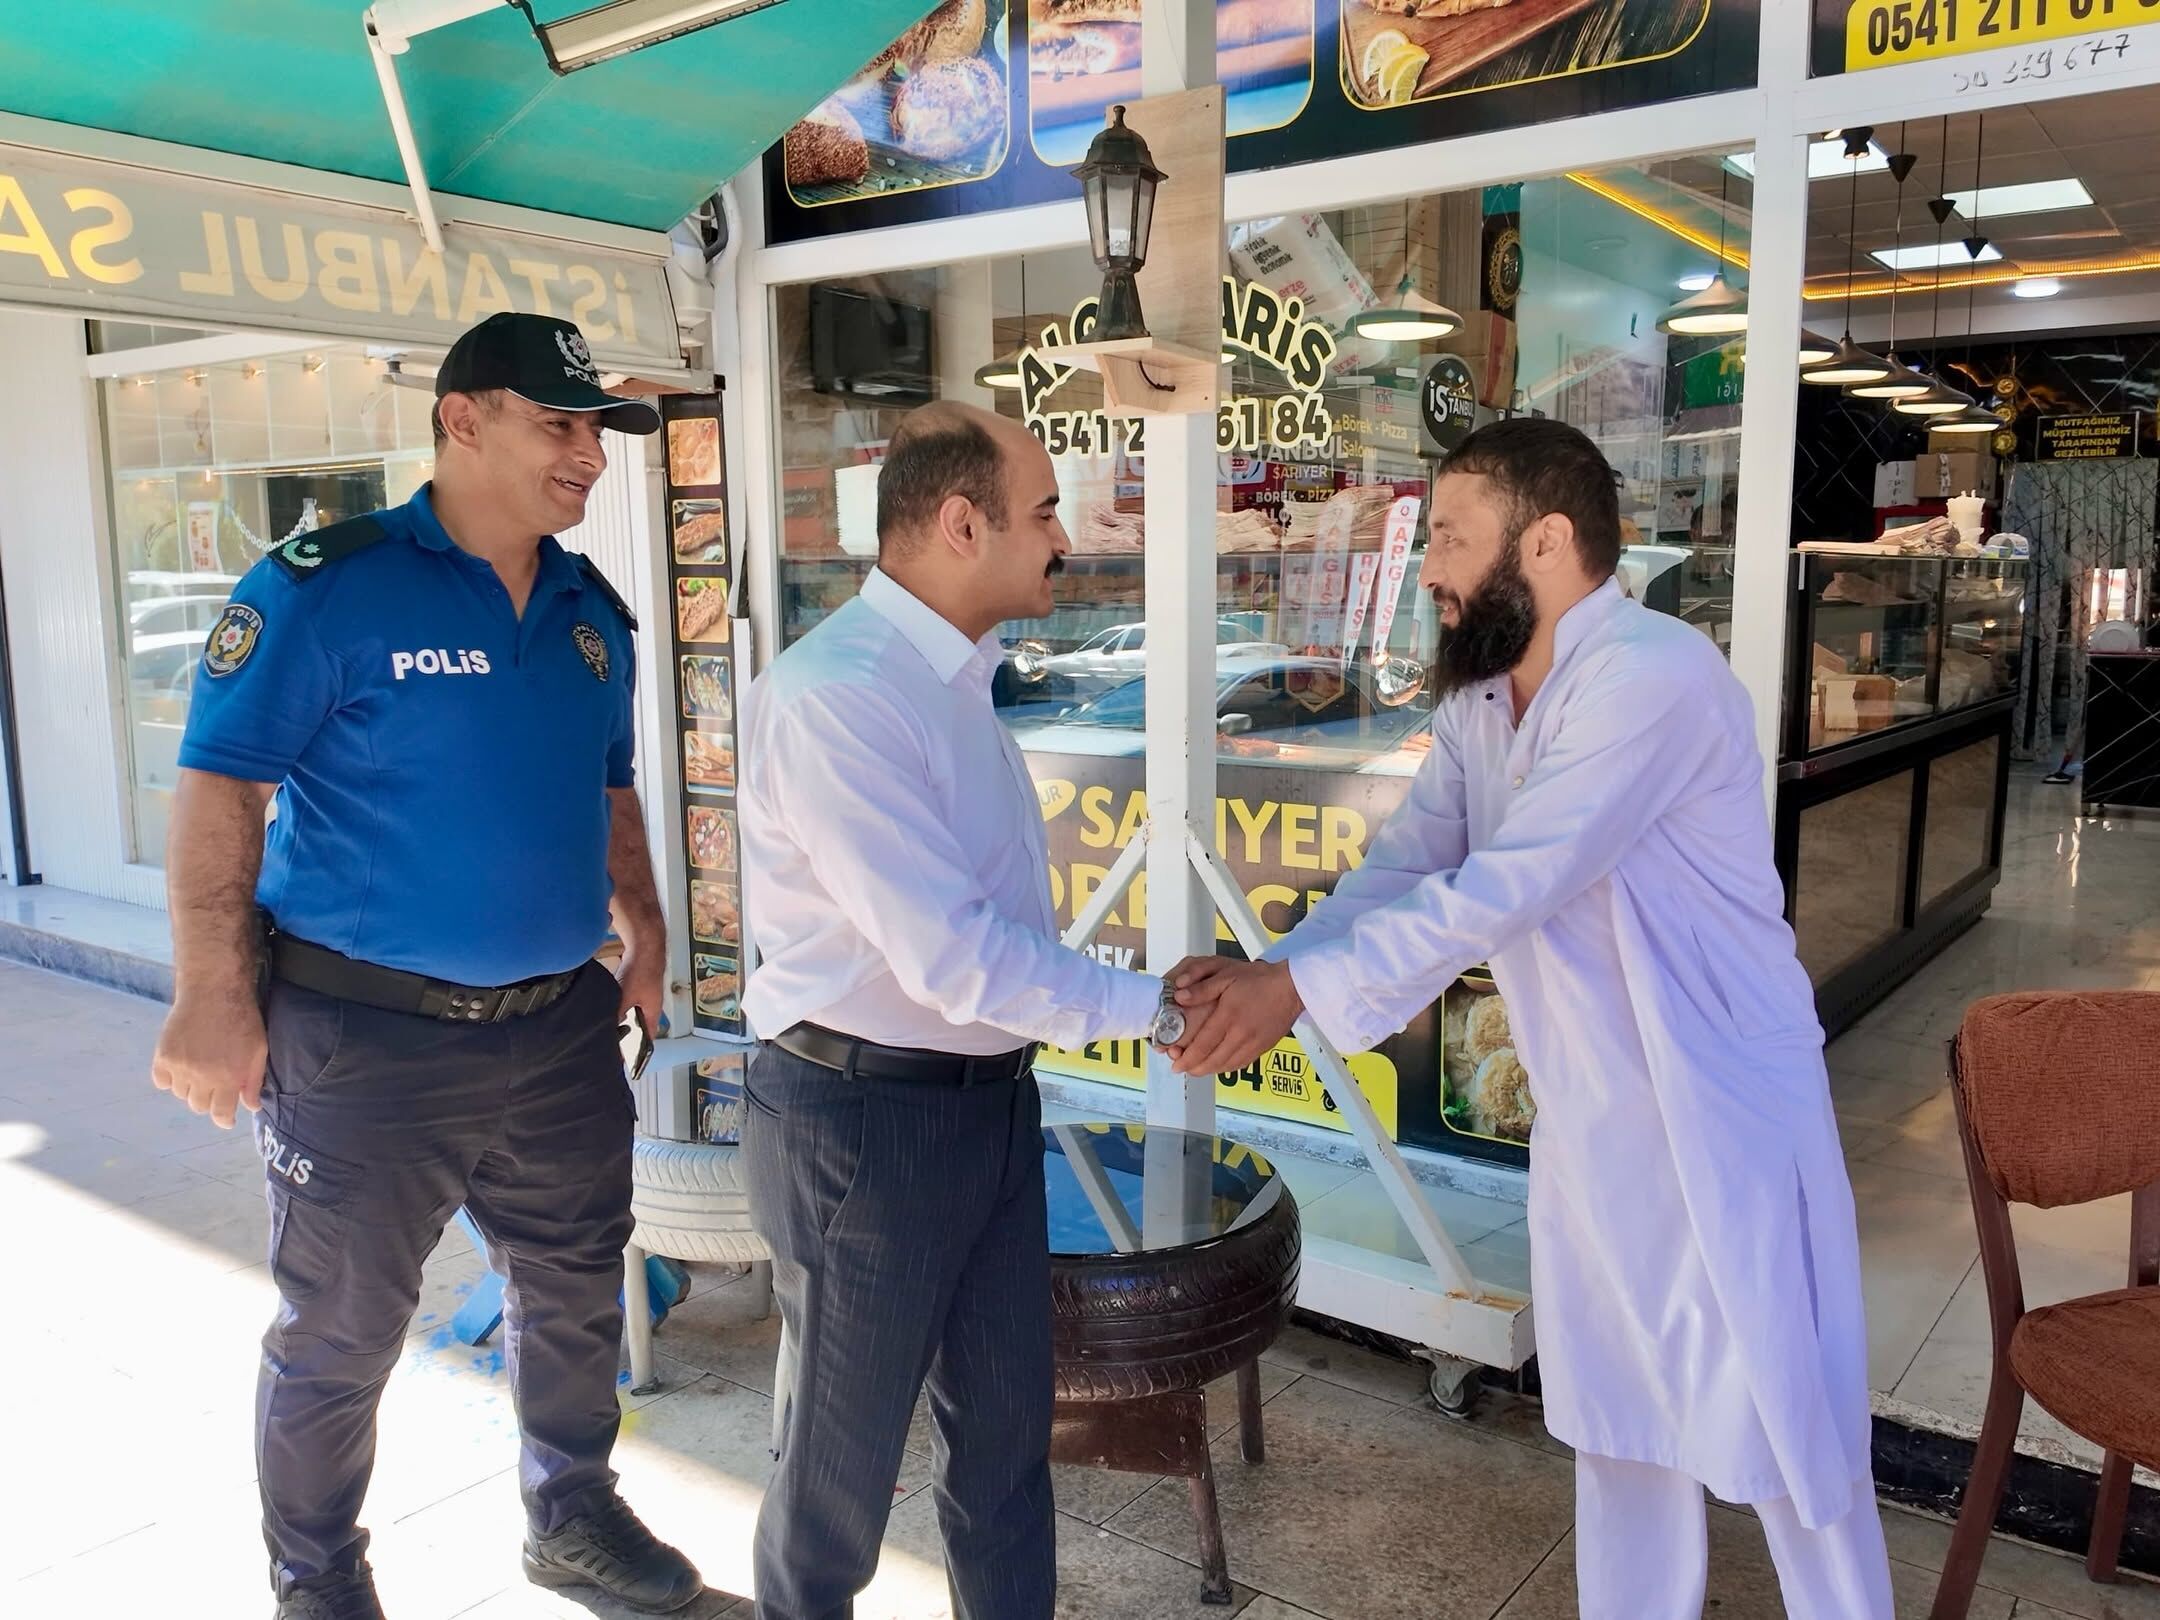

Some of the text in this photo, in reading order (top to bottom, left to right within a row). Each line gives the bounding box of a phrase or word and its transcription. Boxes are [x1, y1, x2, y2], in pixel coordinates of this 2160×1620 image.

[1275, 399, 1327, 443] 84
[2051, 438, 2121, 448] TARAFINDAN
[1271, 1052, 1302, 1074] ALO
